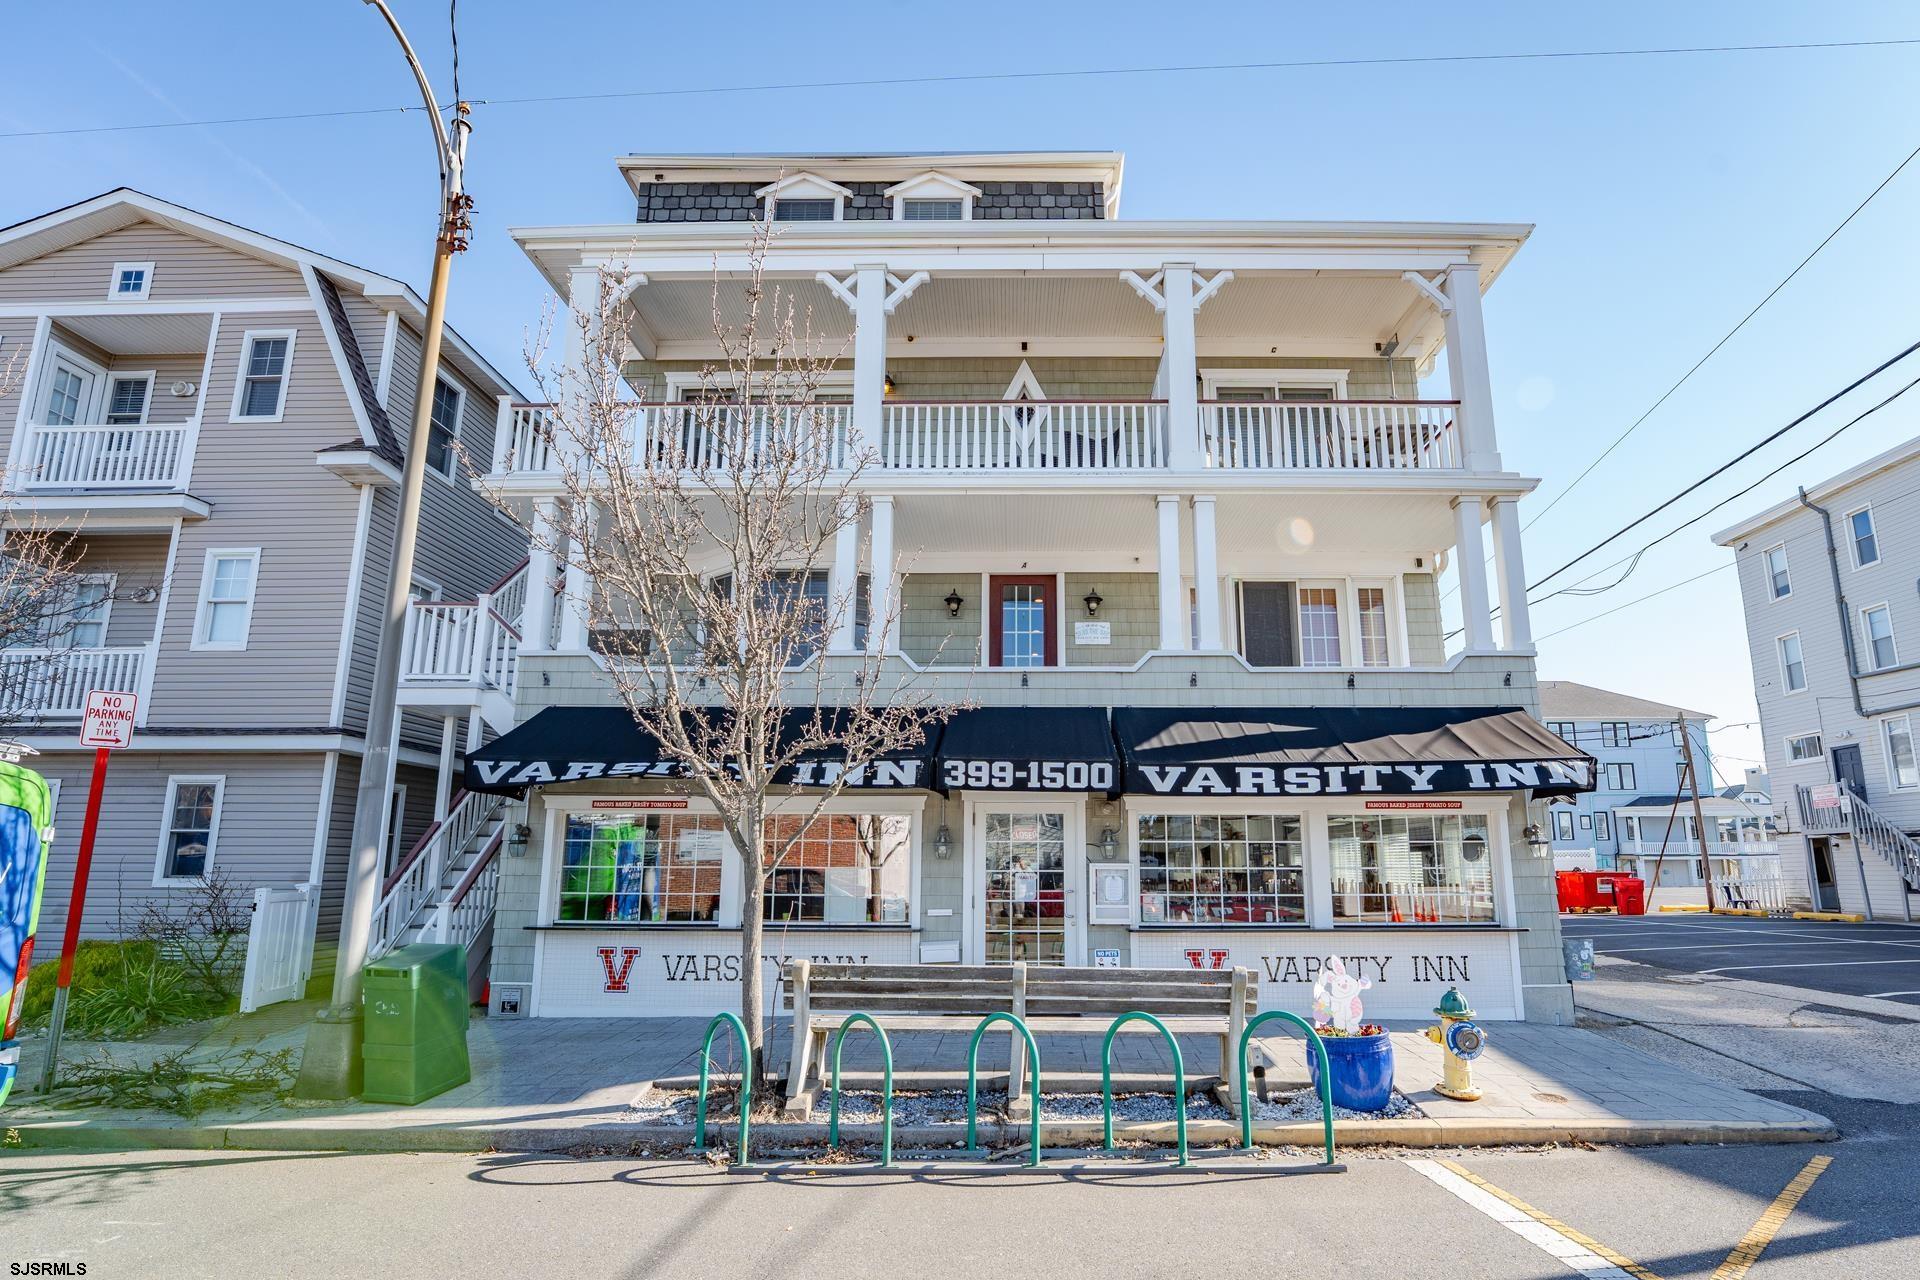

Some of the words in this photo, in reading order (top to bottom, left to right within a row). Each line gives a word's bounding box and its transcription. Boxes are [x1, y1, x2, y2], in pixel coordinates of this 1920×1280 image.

[88, 708, 131, 721] PARKING
[103, 697, 121, 707] NO
[96, 728, 118, 736] TIME
[473, 759, 775, 784] VARSI
[793, 759, 921, 786] INN
[944, 760, 1113, 789] 399-1500
[1138, 764, 1444, 794] VARSITY
[1464, 761, 1591, 789] INN
[597, 946, 641, 993] V
[662, 955, 793, 981] VARSY
[1412, 955, 1471, 982] INN
